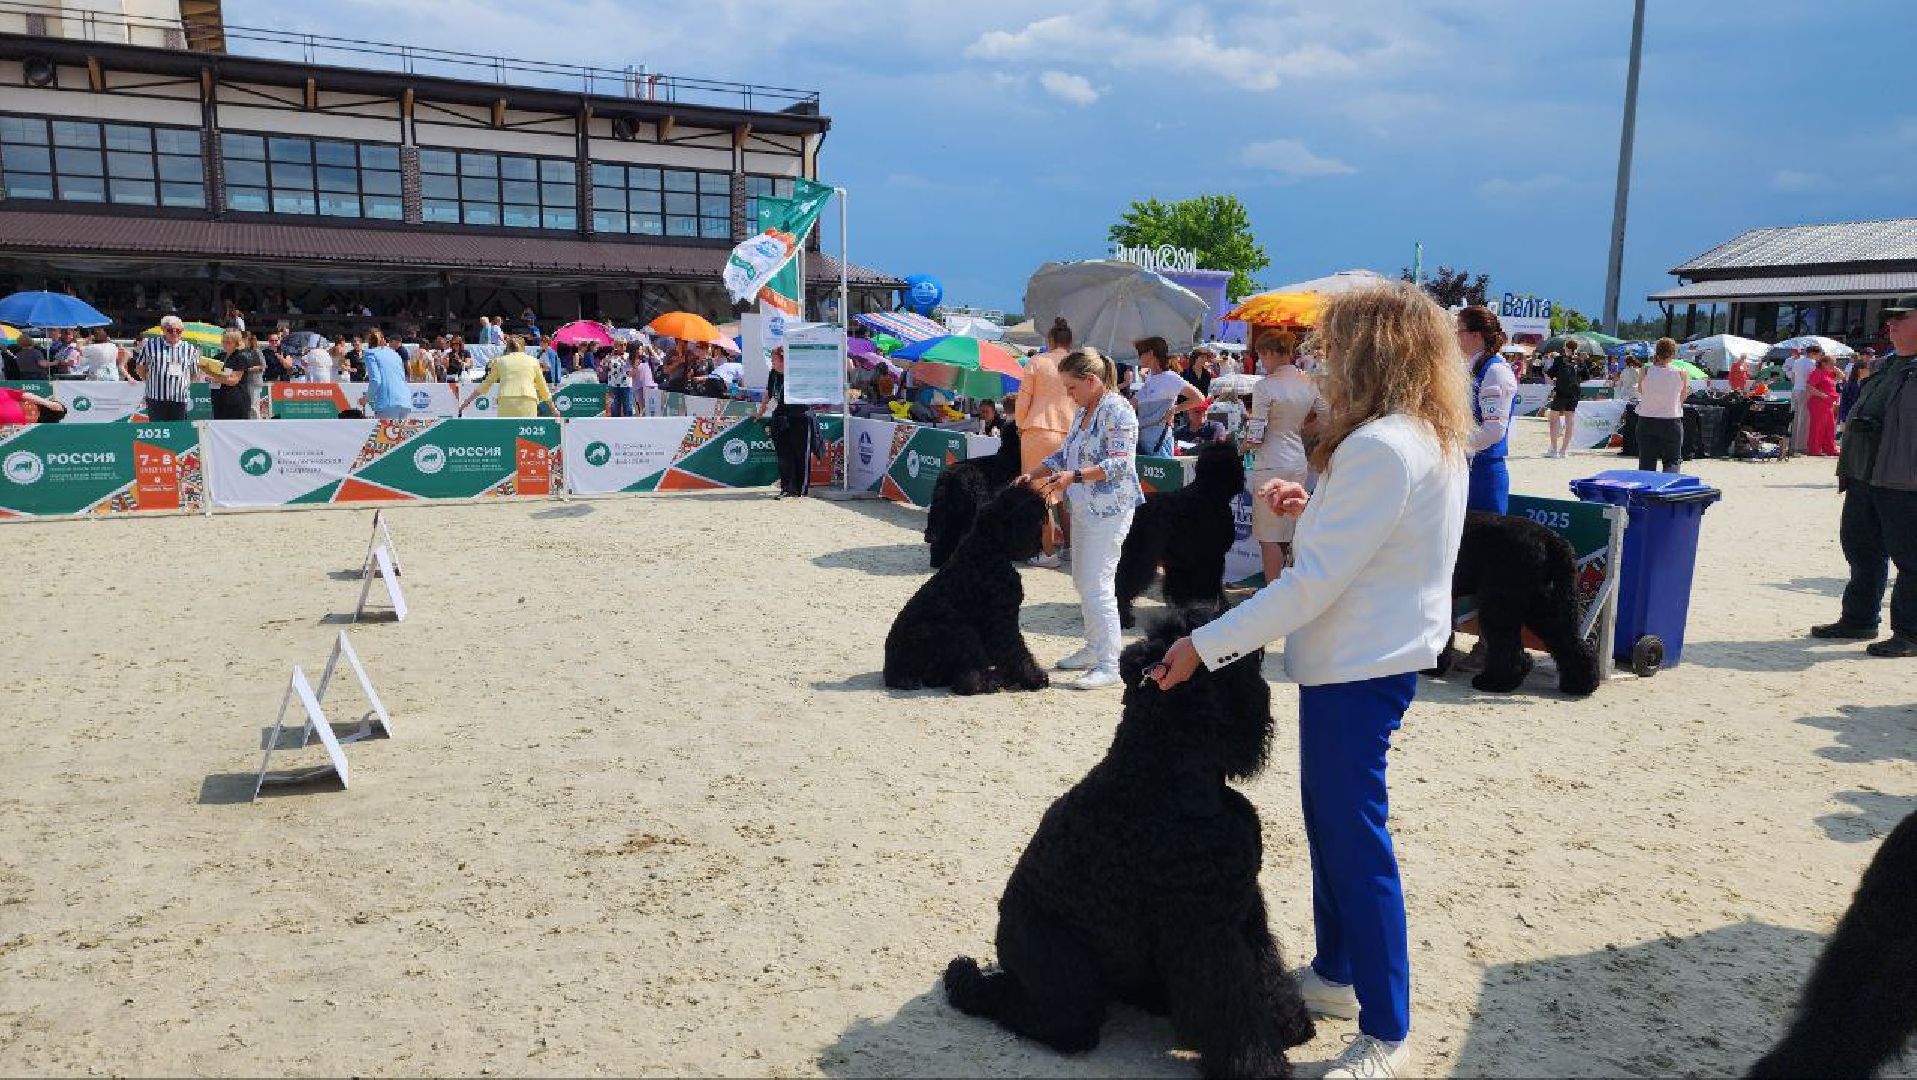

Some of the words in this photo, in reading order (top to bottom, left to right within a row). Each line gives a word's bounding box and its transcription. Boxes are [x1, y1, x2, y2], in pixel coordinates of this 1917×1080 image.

[1502, 292, 1552, 318] Валта
[136, 428, 171, 439] 2025
[518, 426, 546, 436] 2025
[448, 446, 502, 457] РОССИЯ
[520, 449, 528, 459] 7
[537, 448, 546, 459] 8
[47, 452, 116, 465] РОССИЯ
[140, 454, 149, 465] 7
[162, 454, 172, 465] 8
[1143, 465, 1166, 478] 2025
[1526, 509, 1570, 528] 2025
